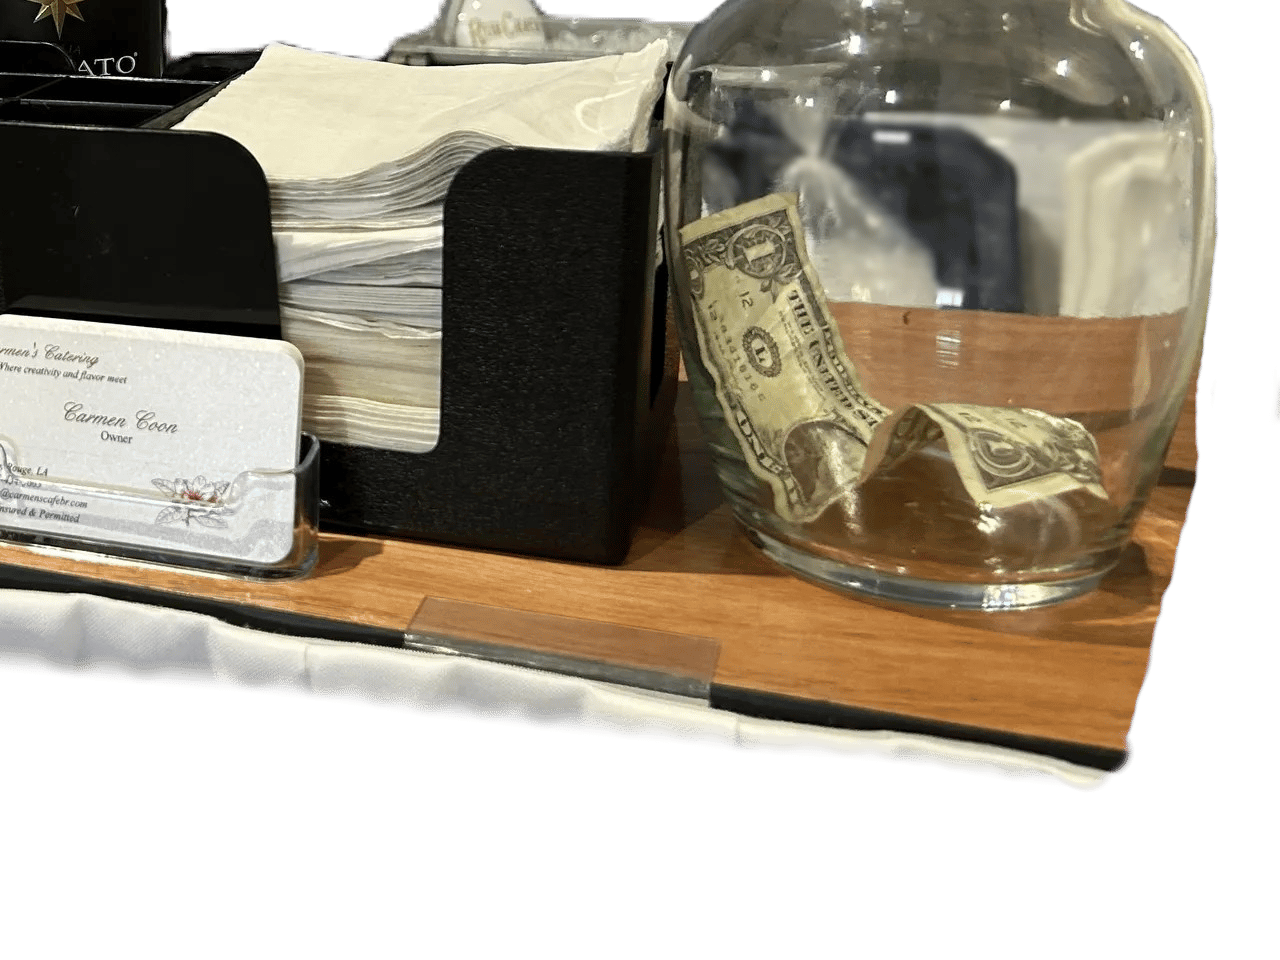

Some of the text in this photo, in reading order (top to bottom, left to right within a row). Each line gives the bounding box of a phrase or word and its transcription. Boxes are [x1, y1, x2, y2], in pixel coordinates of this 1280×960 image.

[787, 289, 815, 336] THE
[44, 344, 100, 369] Catering
[23, 366, 61, 379] creativity
[63, 370, 79, 380] and
[78, 371, 104, 382] flavor
[107, 376, 128, 384] meet
[63, 401, 178, 434] Carmen Coon
[100, 430, 133, 444] Owner
[36, 466, 48, 477] LA
[28, 507, 37, 517] &
[39, 509, 81, 524] Permitted
